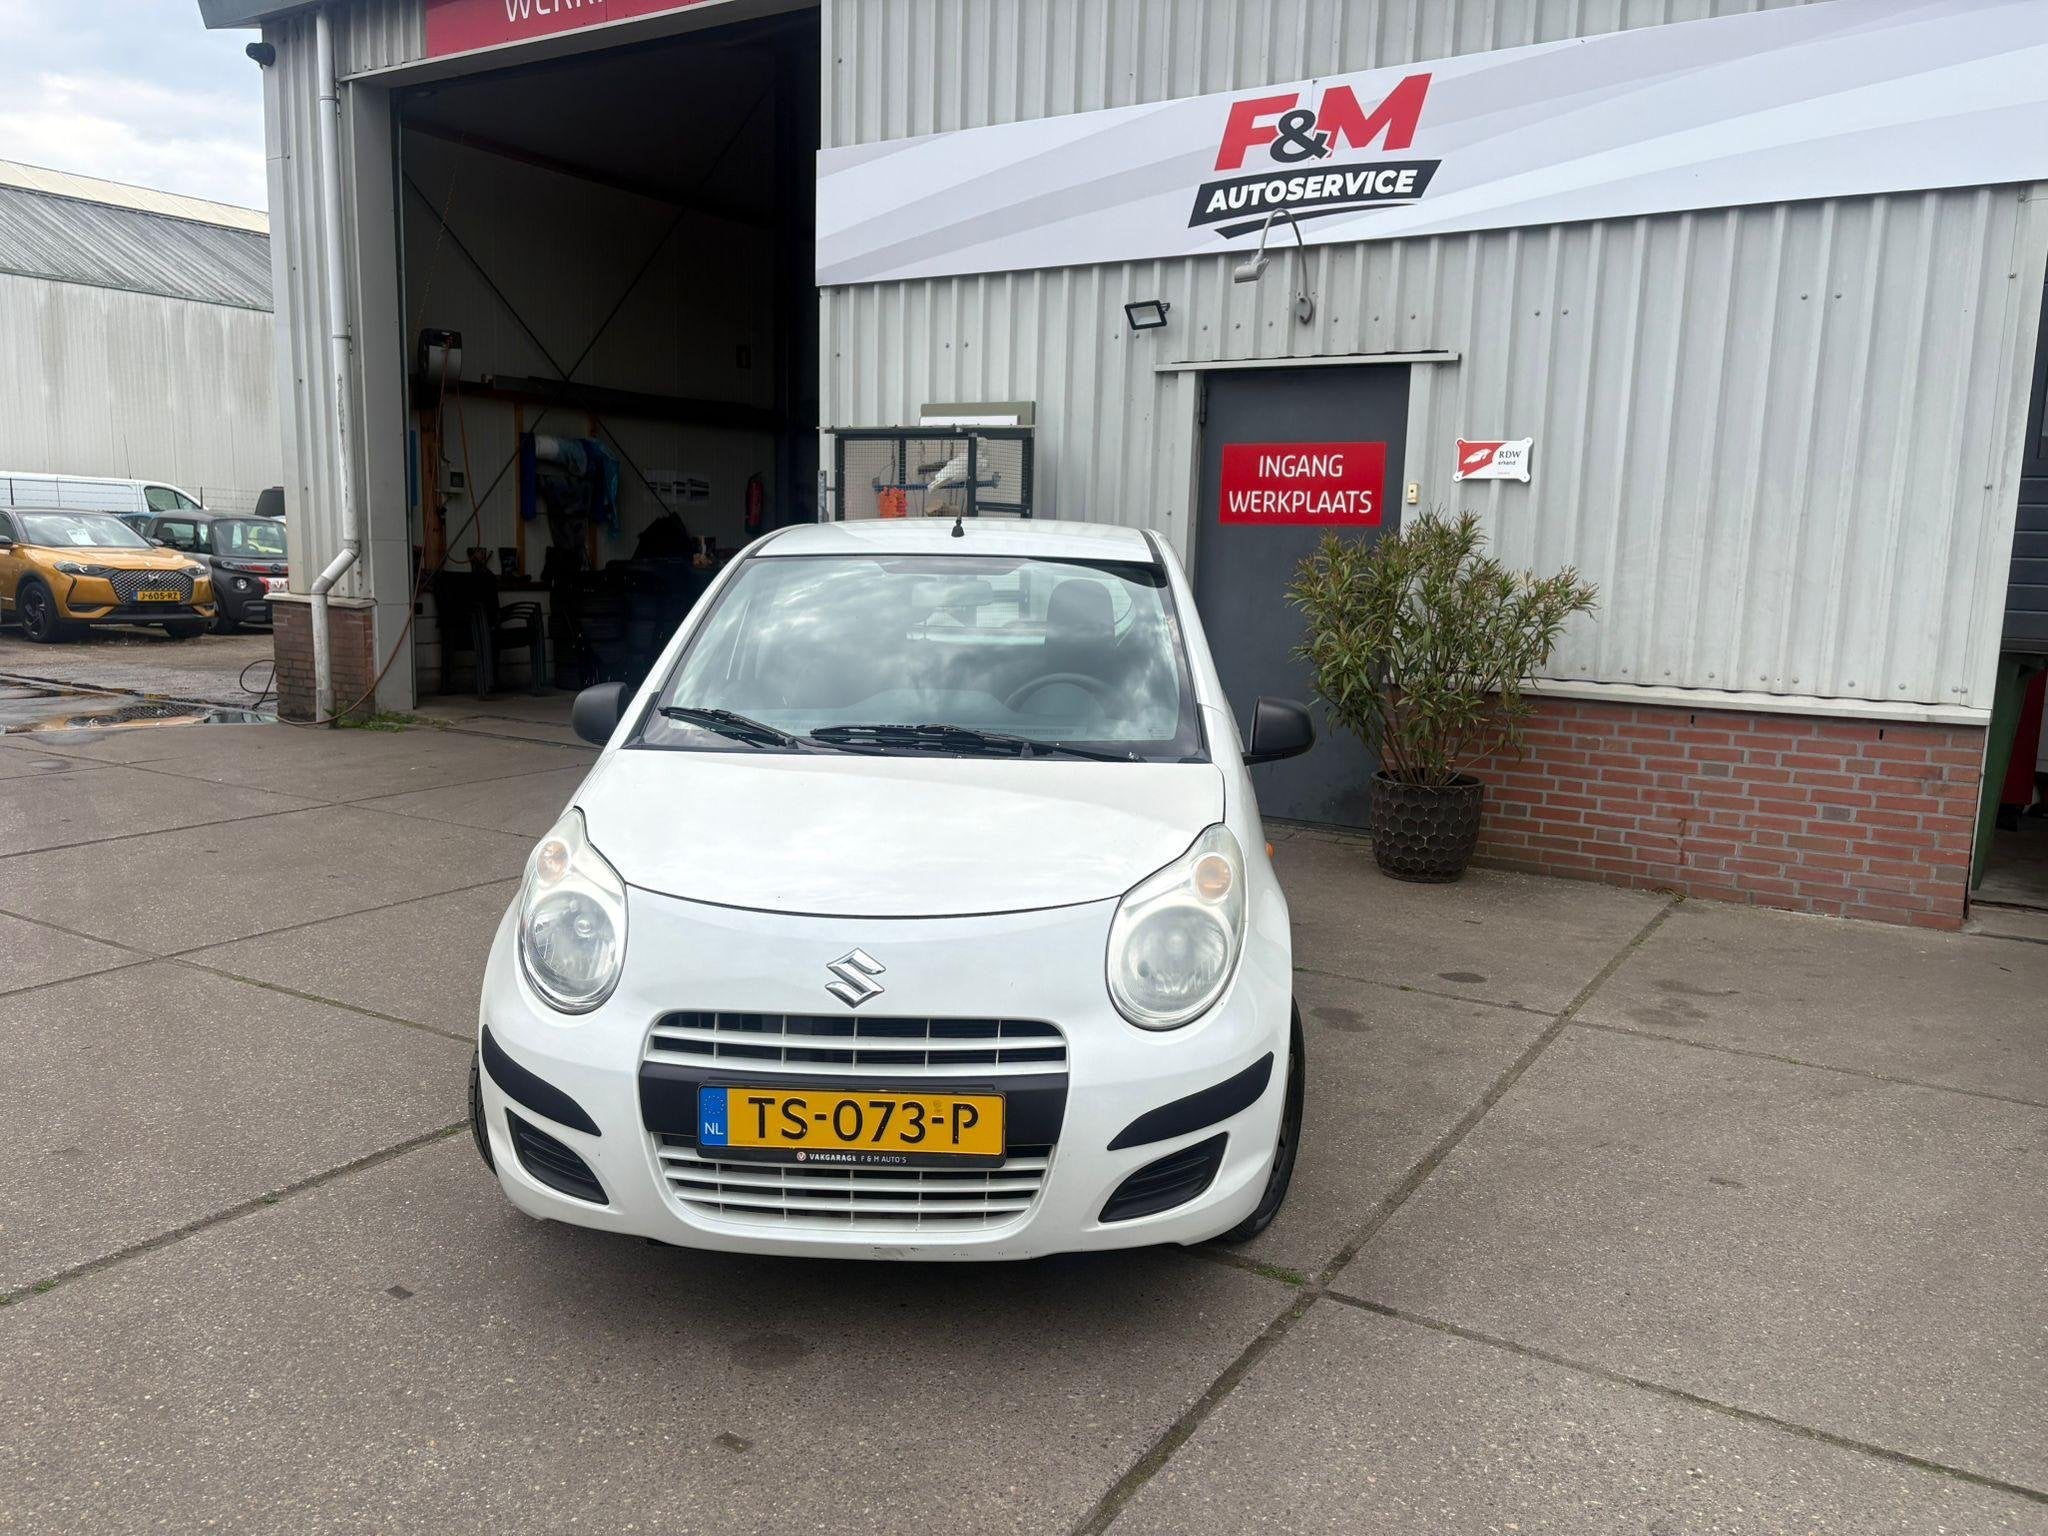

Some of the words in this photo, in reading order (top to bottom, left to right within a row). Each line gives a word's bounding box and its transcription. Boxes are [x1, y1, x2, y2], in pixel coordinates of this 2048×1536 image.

[1214, 72, 1433, 171] F&M
[1205, 169, 1418, 214] AUTOSERVICE
[1258, 454, 1344, 478] INGANG
[1499, 450, 1521, 459] RDW
[1229, 490, 1373, 514] WERKPLAATS
[704, 1122, 724, 1135] NL
[747, 1096, 979, 1145] TS-073-P
[809, 1153, 857, 1162] VAKGARAGE
